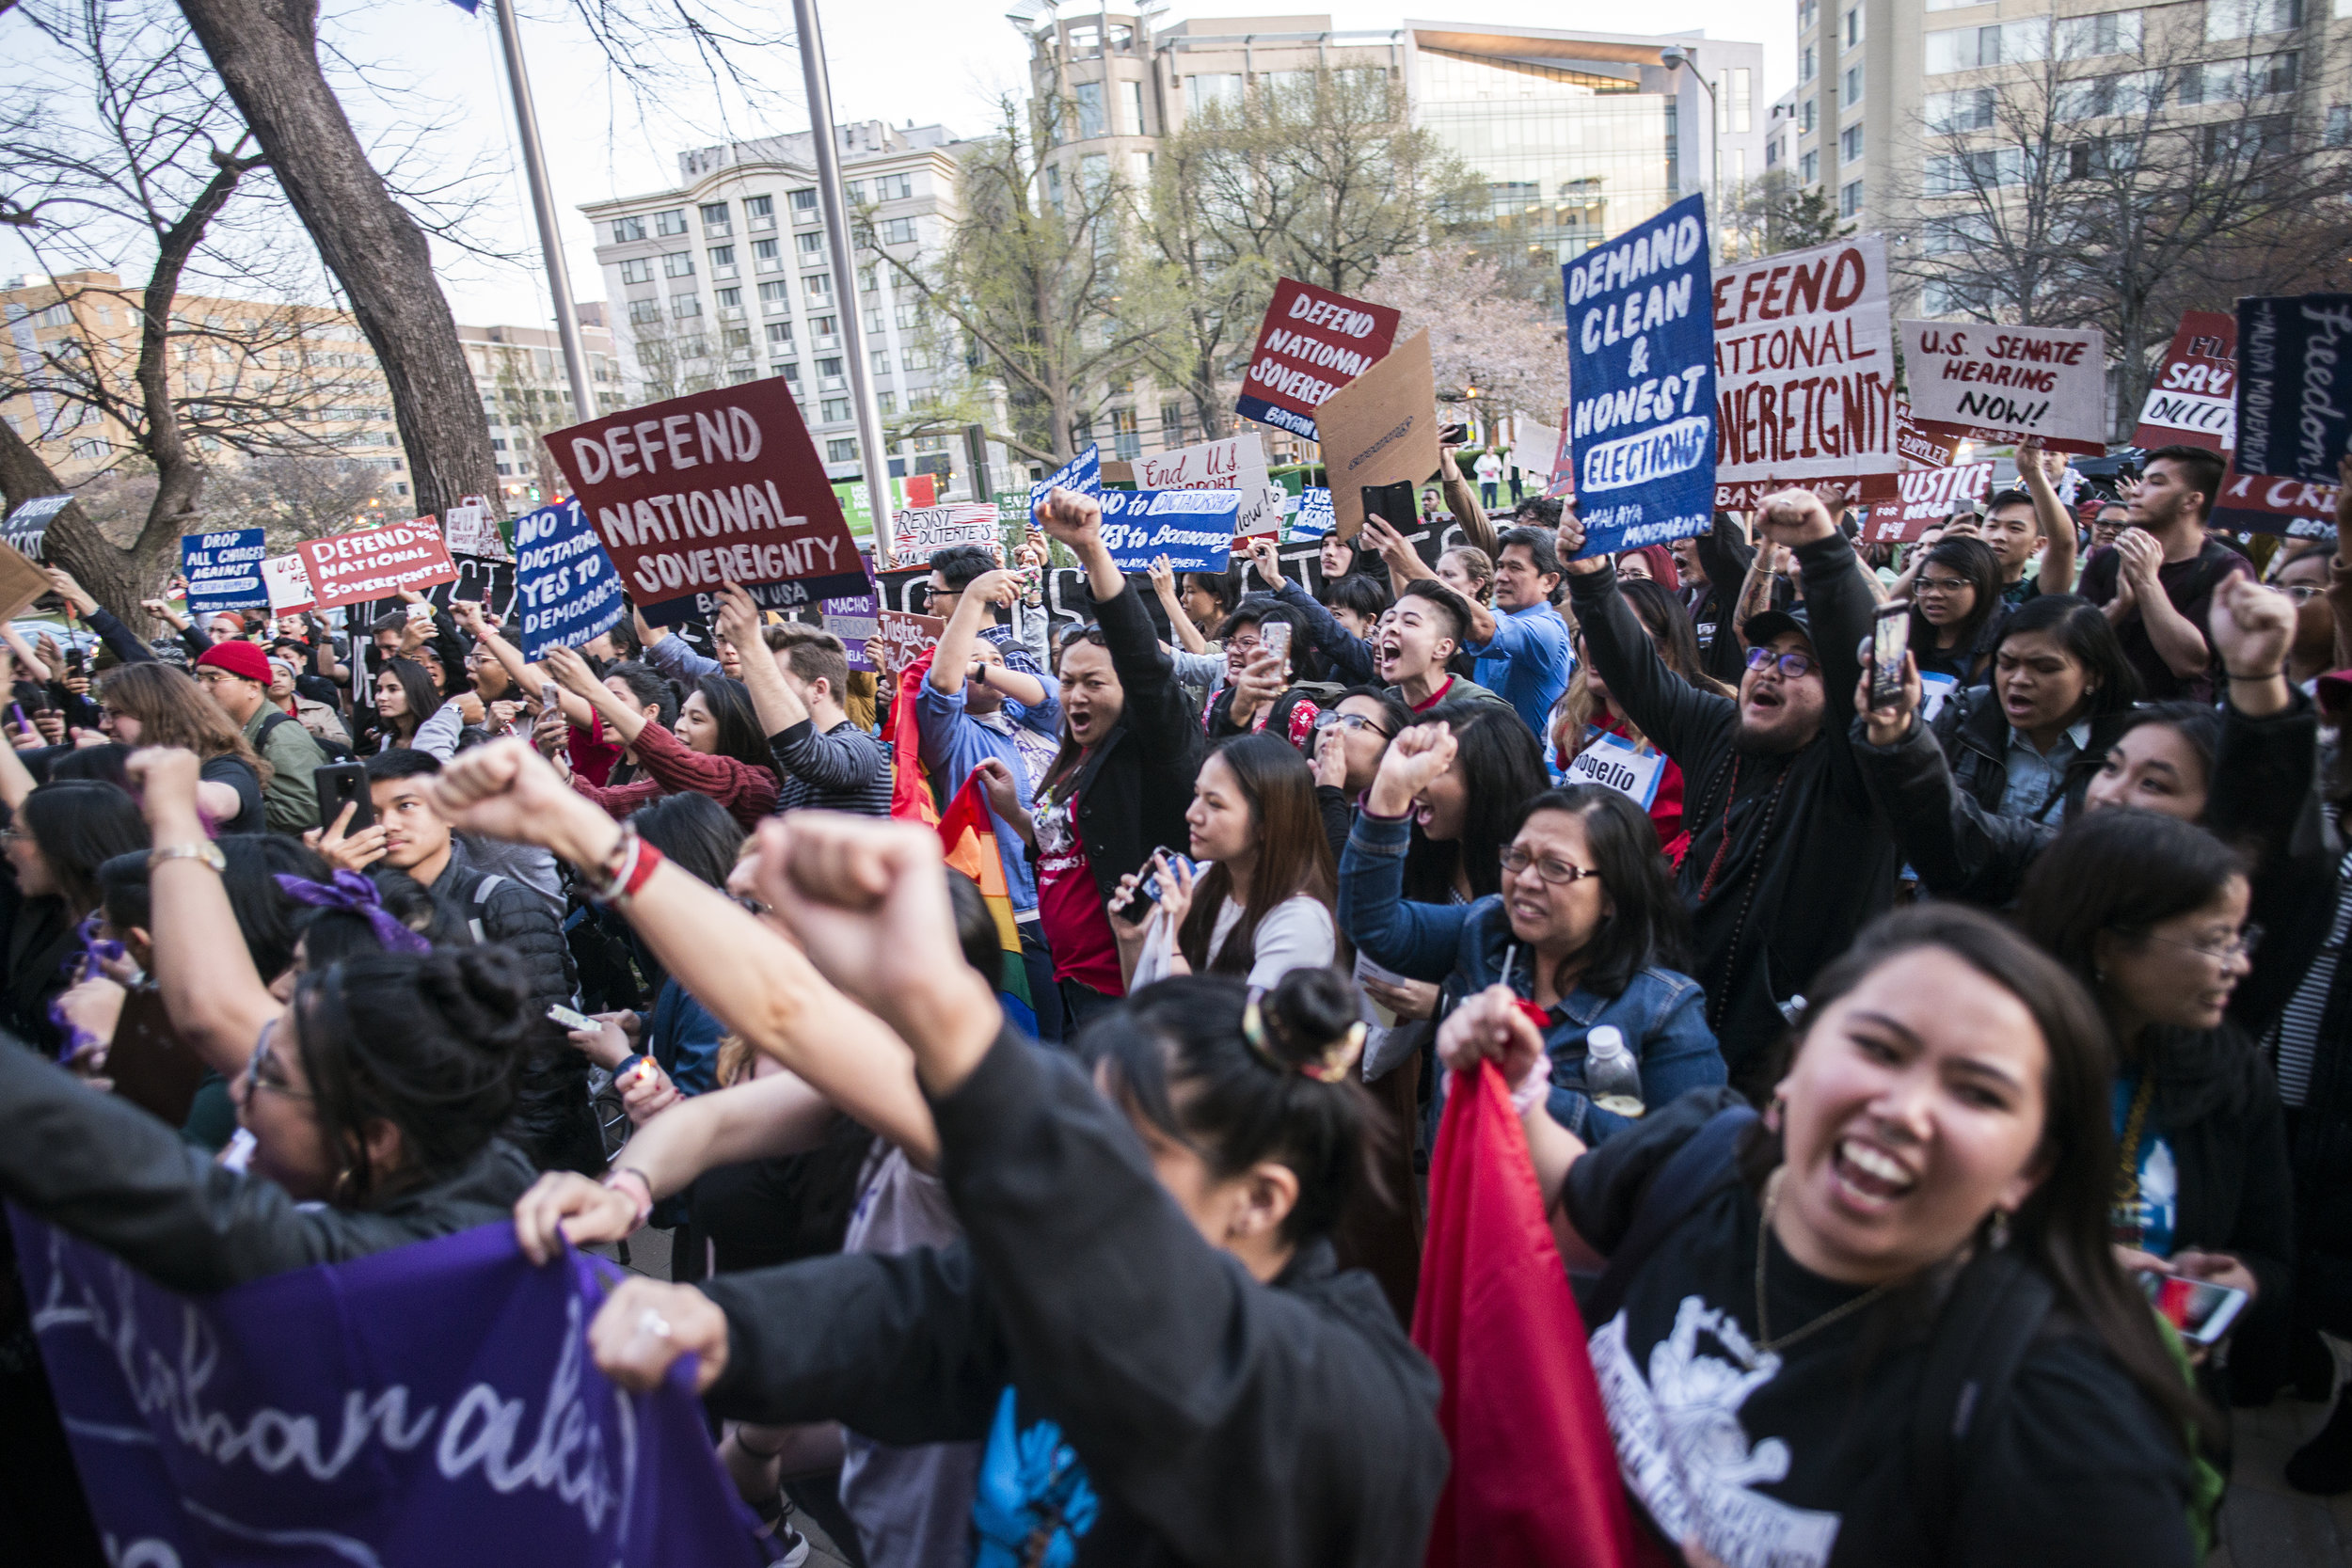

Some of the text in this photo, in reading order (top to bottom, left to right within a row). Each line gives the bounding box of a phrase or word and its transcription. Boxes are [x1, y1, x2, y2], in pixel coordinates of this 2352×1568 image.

[1568, 215, 1701, 306] DEMAND
[1714, 247, 1866, 330] EFEND
[1288, 293, 1375, 339] DEFEND
[1581, 273, 1692, 355] CLEAN
[1629, 336, 1649, 377] &
[1714, 317, 1877, 376] ATIONAL
[1920, 331, 2089, 366] U.S. SENATE
[1942, 359, 2058, 393] HEARING
[2162, 362, 2232, 394] SAY
[1574, 365, 1707, 438] HONEST
[1956, 390, 2050, 428] NOW!
[1264, 406, 1315, 436] BAYAN
[572, 406, 762, 484] DEFEND
[1589, 424, 1705, 485] ELECTIONS
[1141, 455, 1186, 487] End
[598, 480, 807, 547] NATIONAL
[1099, 493, 1126, 516] NO
[1129, 494, 1149, 516] to
[2265, 479, 2338, 513] CRI
[517, 513, 557, 546] NO
[567, 500, 587, 527] T
[896, 509, 955, 535] RESIST
[1128, 527, 1149, 549] to
[187, 546, 265, 566] ALL CHARGES
[202, 532, 241, 548] DROP
[311, 528, 415, 563] DEFEND
[192, 563, 254, 579] AGAINST
[318, 546, 432, 579] NATIONAL
[633, 535, 839, 593] SOVEREIGNTY
[520, 566, 570, 608] YES
[575, 554, 600, 585] TO
[770, 580, 809, 605] USA
[828, 597, 873, 615] MACHO-
[880, 614, 924, 642] Justice
